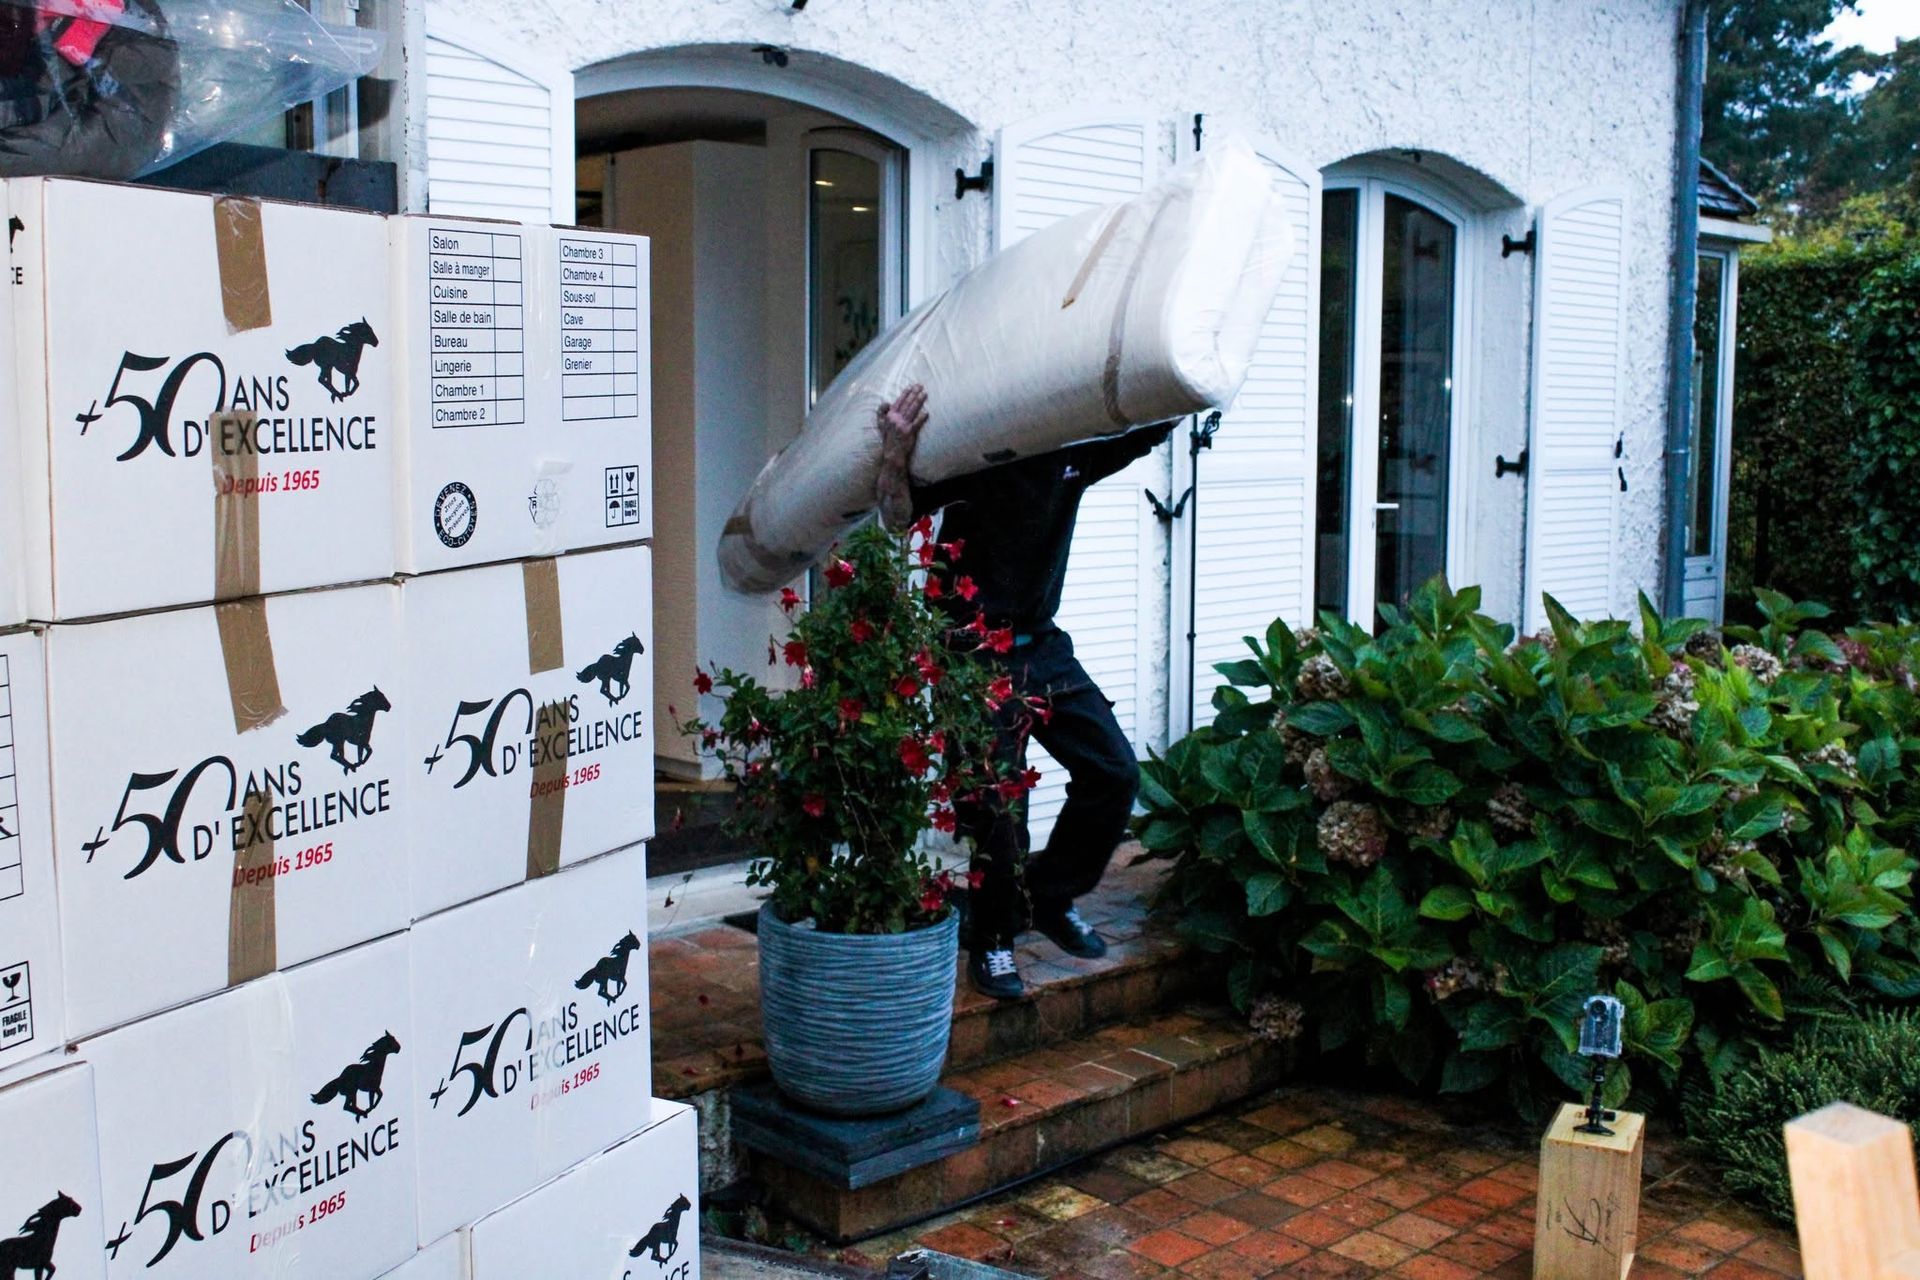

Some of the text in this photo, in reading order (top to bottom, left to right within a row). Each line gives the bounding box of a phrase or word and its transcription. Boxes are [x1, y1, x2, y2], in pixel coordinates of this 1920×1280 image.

[433, 236, 459, 249] Salon
[562, 245, 604, 259] Chambre 3
[433, 260, 490, 278] Salle à manger
[563, 268, 604, 281] Chambre 4
[433, 285, 468, 299] Cuisine
[563, 290, 596, 303] Sous-sol
[434, 310, 492, 323] Salle de bain
[563, 313, 584, 325] Cave
[434, 335, 468, 348] Bureau
[564, 335, 592, 350] Garage
[435, 359, 472, 375] Lingerie
[564, 358, 593, 370] Grenier
[232, 375, 289, 412] ANS
[435, 384, 484, 397] Chambre 1
[436, 407, 485, 422] Chambre 2
[222, 470, 320, 497] Depuis 1965
[536, 694, 580, 732] ANS
[242, 761, 301, 808] ANS
[530, 763, 601, 799] Depuis 1965
[233, 842, 333, 888] Depuis 1965
[2, 1010, 27, 1027] FRAGILE
[537, 1002, 578, 1045] ANS
[573, 1062, 600, 1089] 1965
[259, 1120, 316, 1175] ANS
[309, 1191, 346, 1225] 1965
